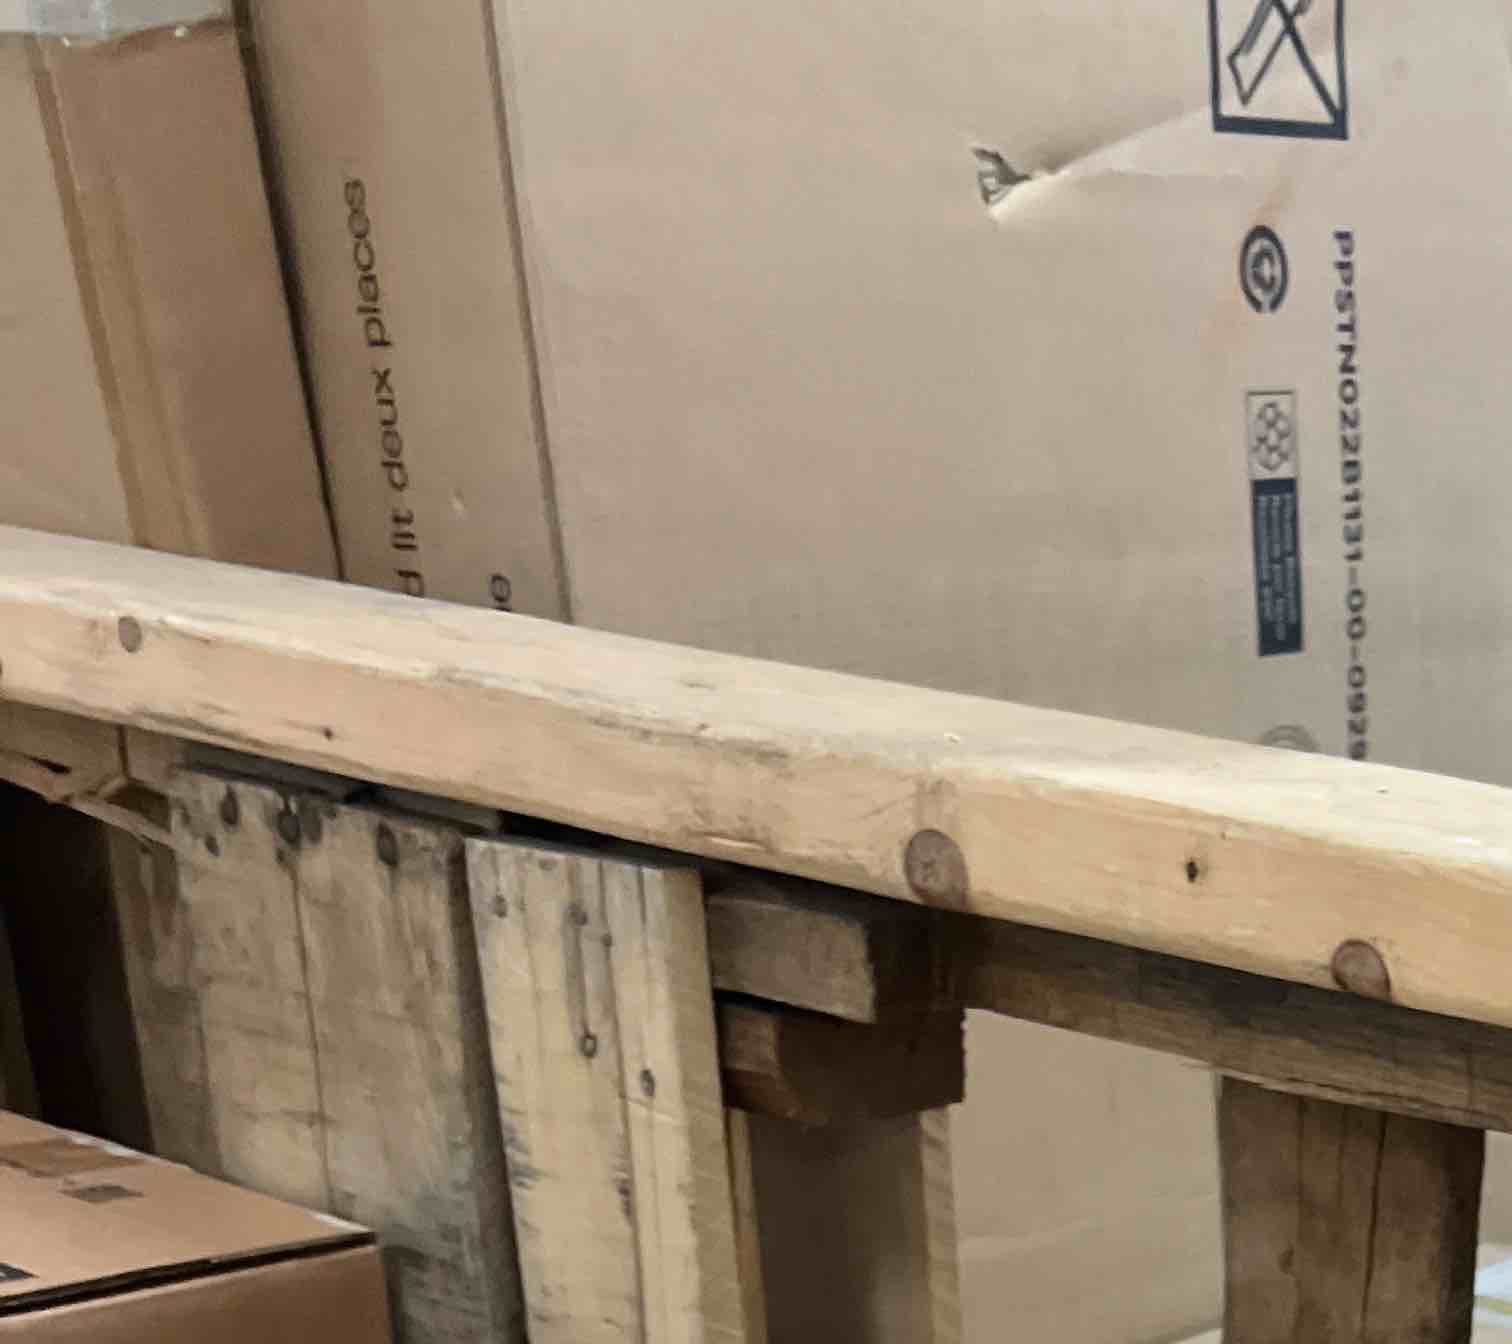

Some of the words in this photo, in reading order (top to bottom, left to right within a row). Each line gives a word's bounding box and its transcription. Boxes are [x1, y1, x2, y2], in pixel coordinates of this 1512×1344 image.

[343, 178, 392, 349] places
[371, 366, 410, 493] deux
[390, 507, 419, 553] lit
